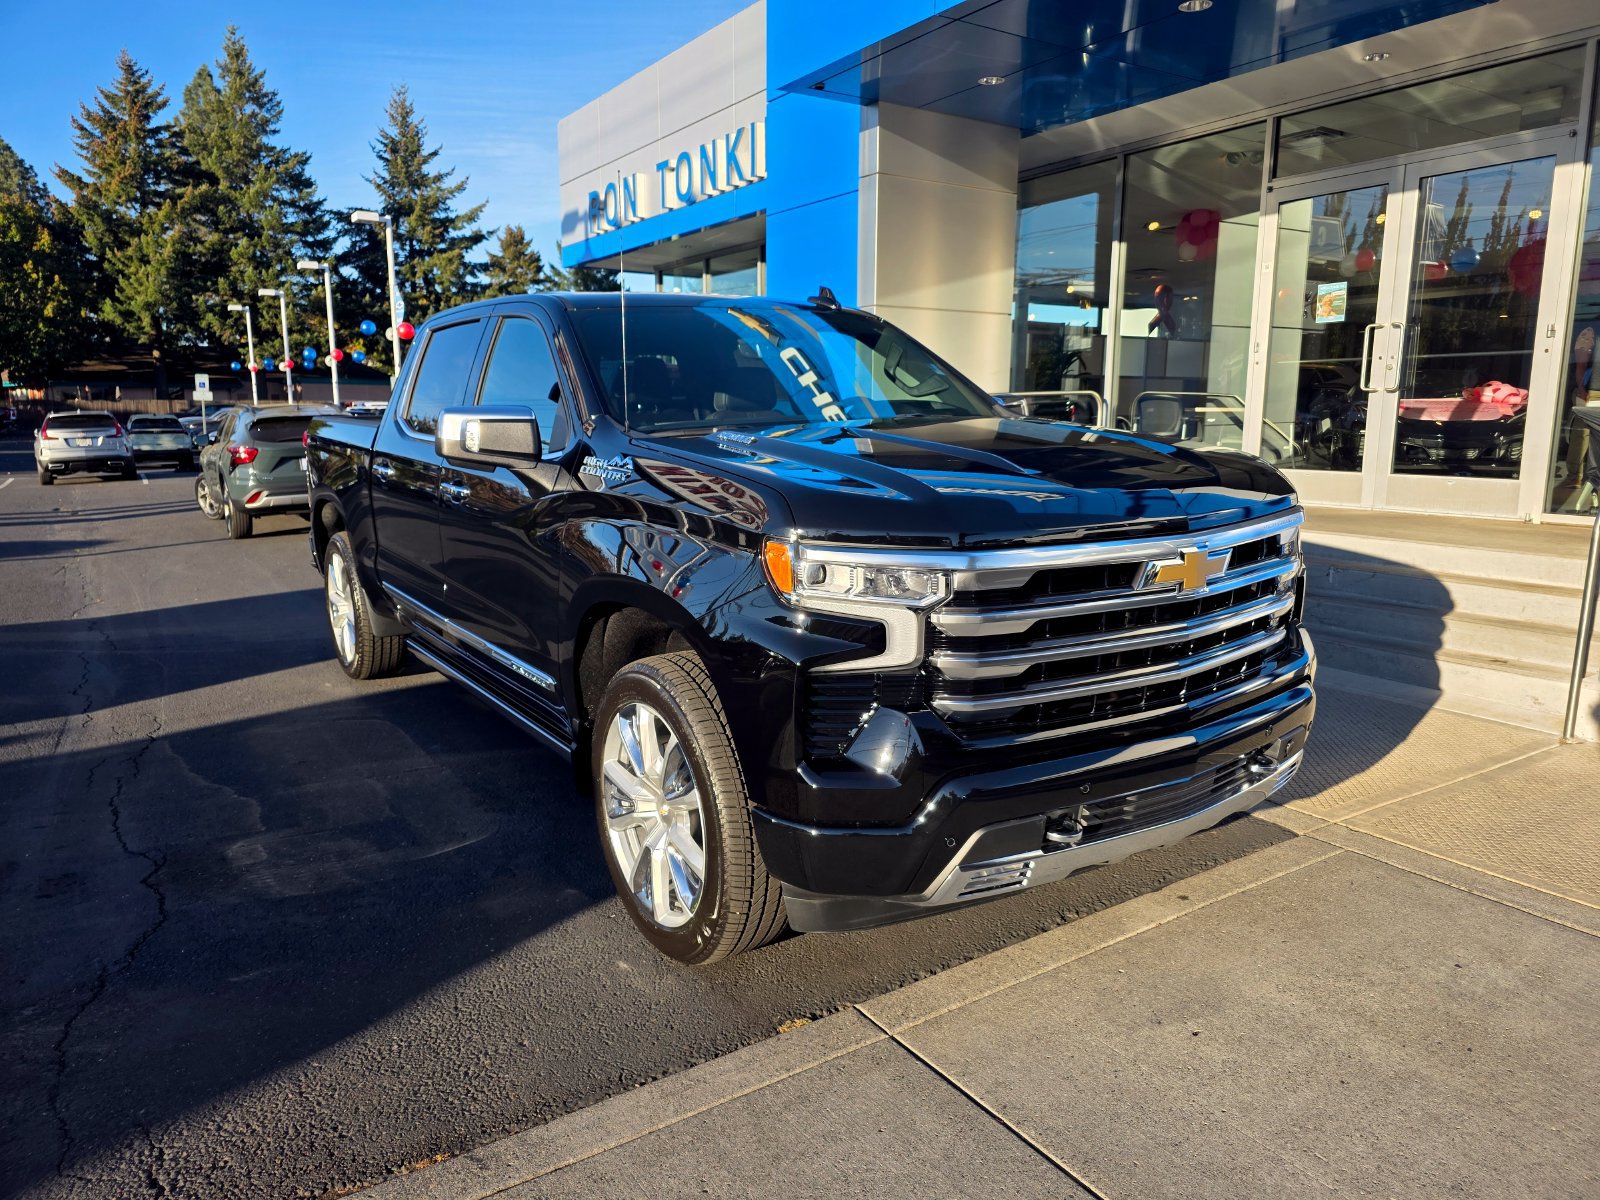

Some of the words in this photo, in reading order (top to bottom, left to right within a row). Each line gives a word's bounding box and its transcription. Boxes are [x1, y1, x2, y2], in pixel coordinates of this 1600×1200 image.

[588, 173, 638, 234] RON
[583, 455, 608, 470] HIGH
[580, 465, 631, 482] COUNTRY
